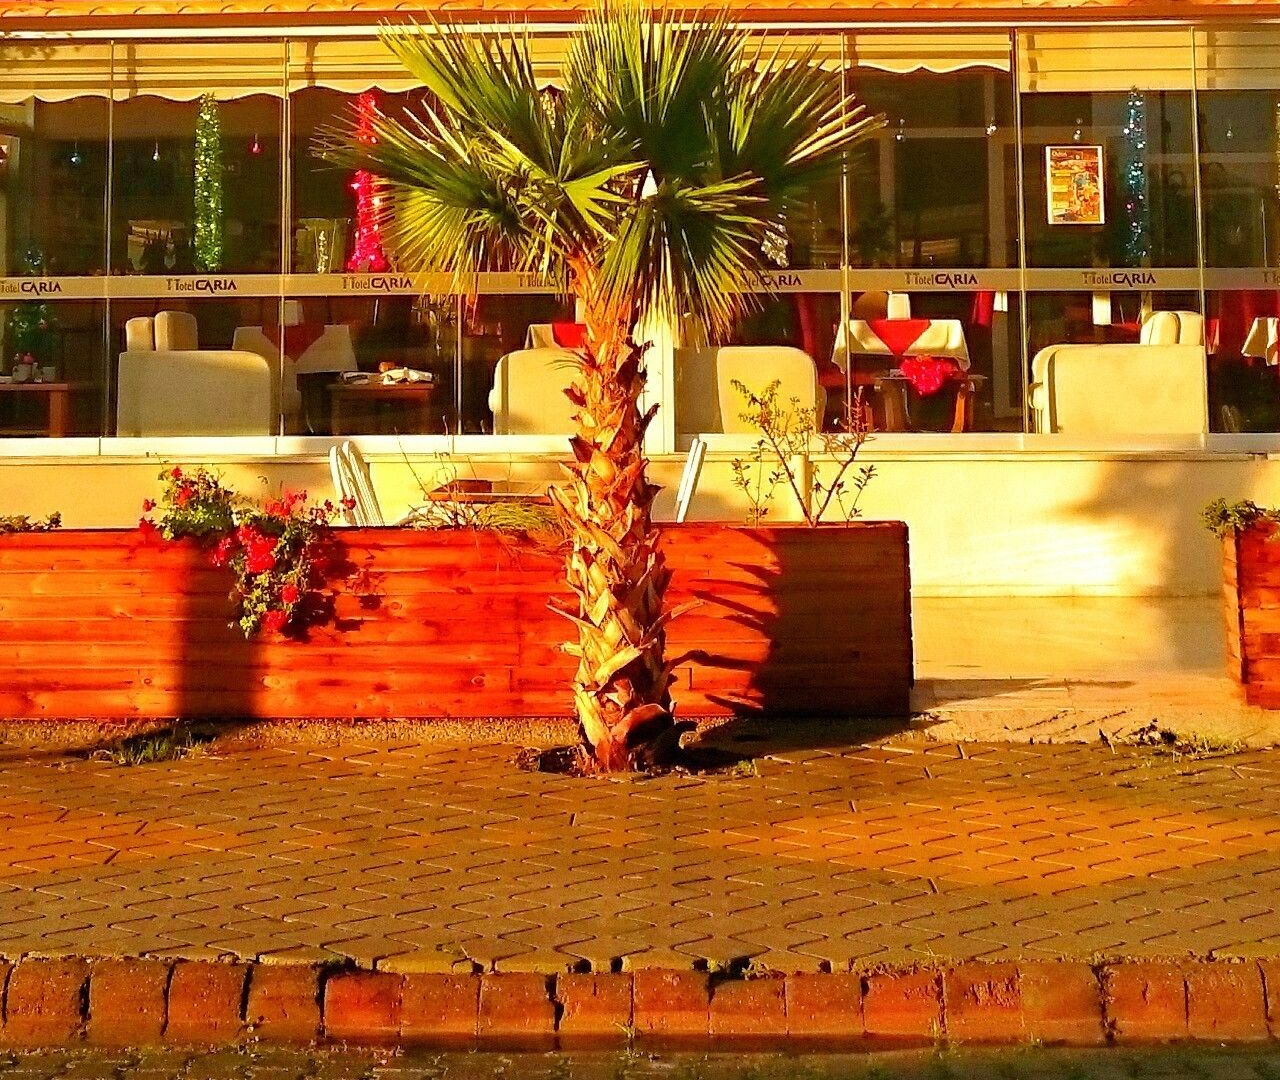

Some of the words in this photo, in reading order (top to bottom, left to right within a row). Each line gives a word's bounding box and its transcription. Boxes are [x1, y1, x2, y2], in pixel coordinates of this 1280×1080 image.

[195, 279, 237, 294] CARIA
[371, 277, 412, 292] CARIA
[934, 273, 978, 288] CARIA
[1112, 272, 1156, 287] CARIA
[20, 281, 62, 295] CARIA
